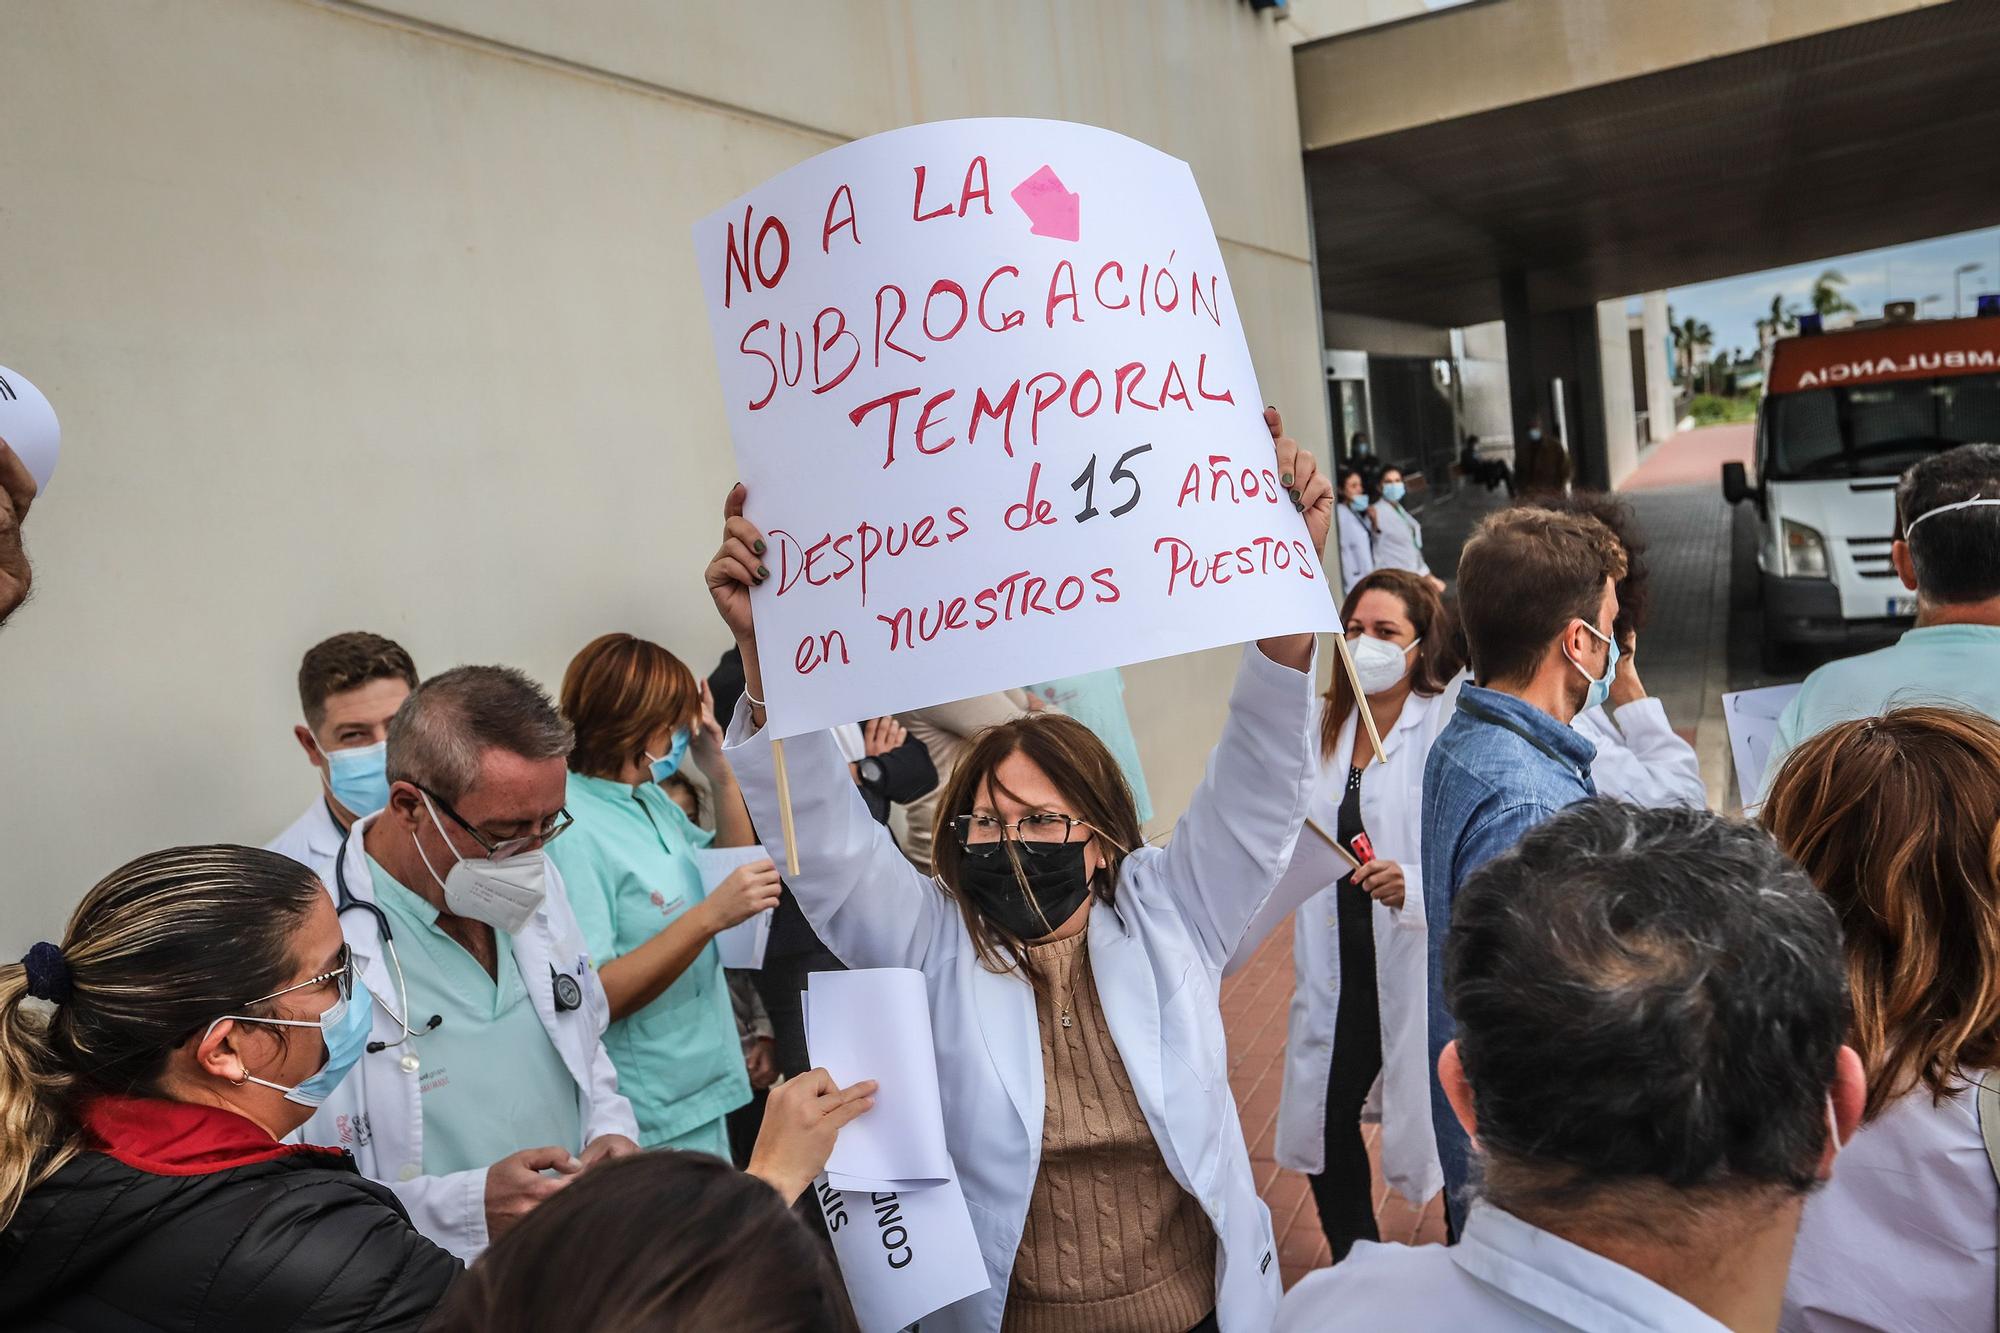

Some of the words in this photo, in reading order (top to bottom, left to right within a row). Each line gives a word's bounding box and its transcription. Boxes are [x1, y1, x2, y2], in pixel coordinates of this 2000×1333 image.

[726, 206, 790, 308] NO
[823, 185, 862, 253] A
[913, 157, 993, 222] LA
[740, 250, 1220, 411] SUBROGACIÓN
[848, 354, 1235, 469] TEMPORAL
[1005, 464, 1058, 532] de
[1072, 445, 1153, 524] 15
[797, 631, 850, 674] en
